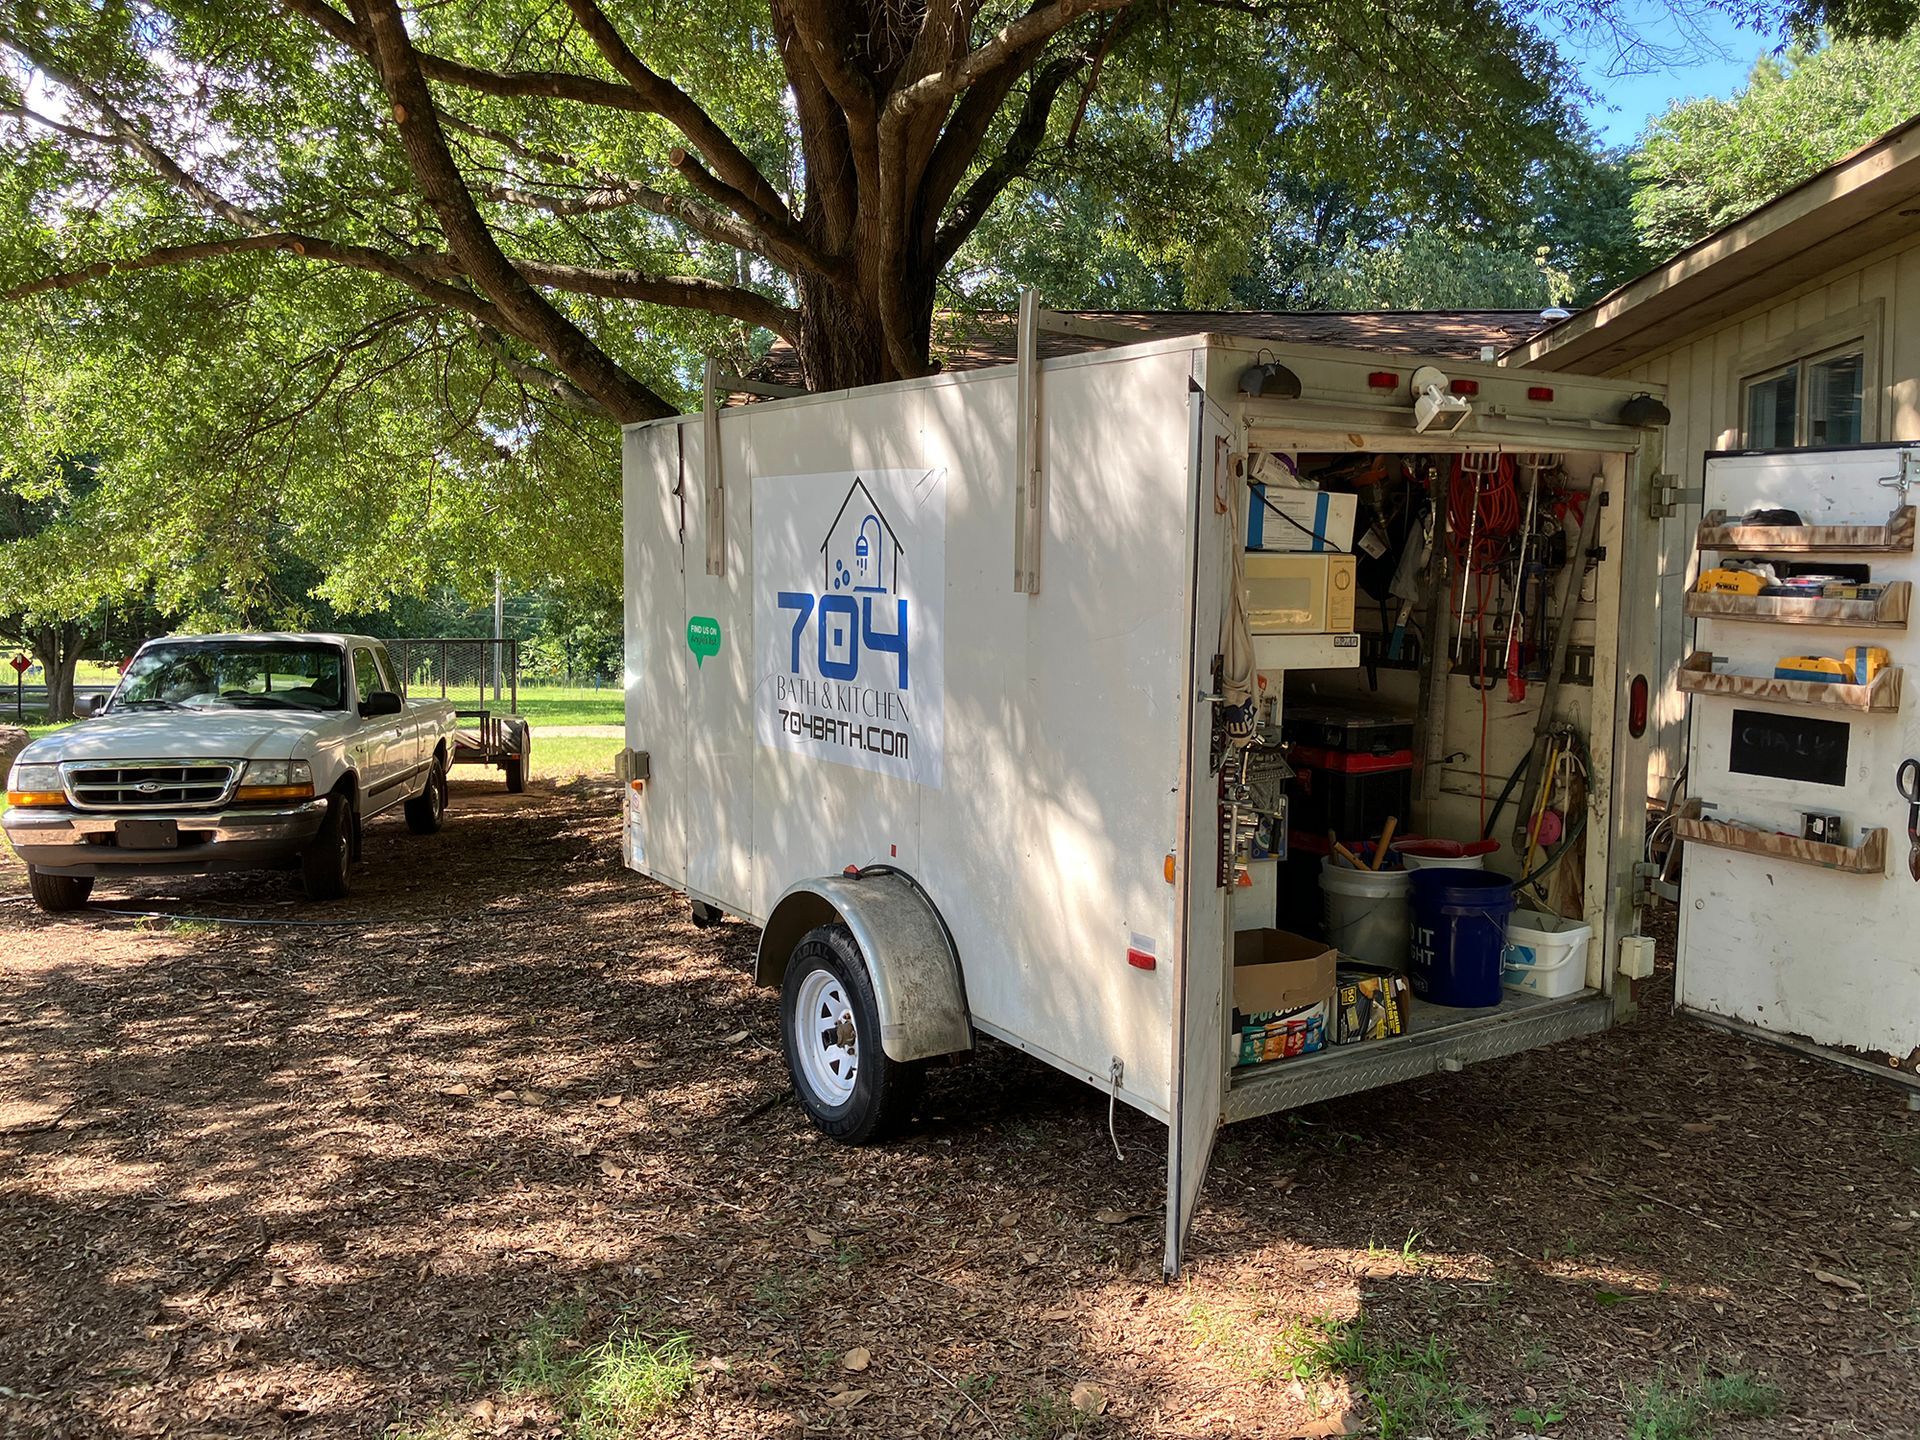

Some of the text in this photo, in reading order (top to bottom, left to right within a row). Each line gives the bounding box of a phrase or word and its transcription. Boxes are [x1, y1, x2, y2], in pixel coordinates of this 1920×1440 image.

[690, 624, 718, 636] FIND US ON
[777, 592, 908, 689] 704
[777, 675, 909, 722] BATH & KITCHEN
[779, 708, 909, 760] 704BATH.COM
[1418, 927, 1435, 947] IT
[1410, 944, 1435, 966] GHT
